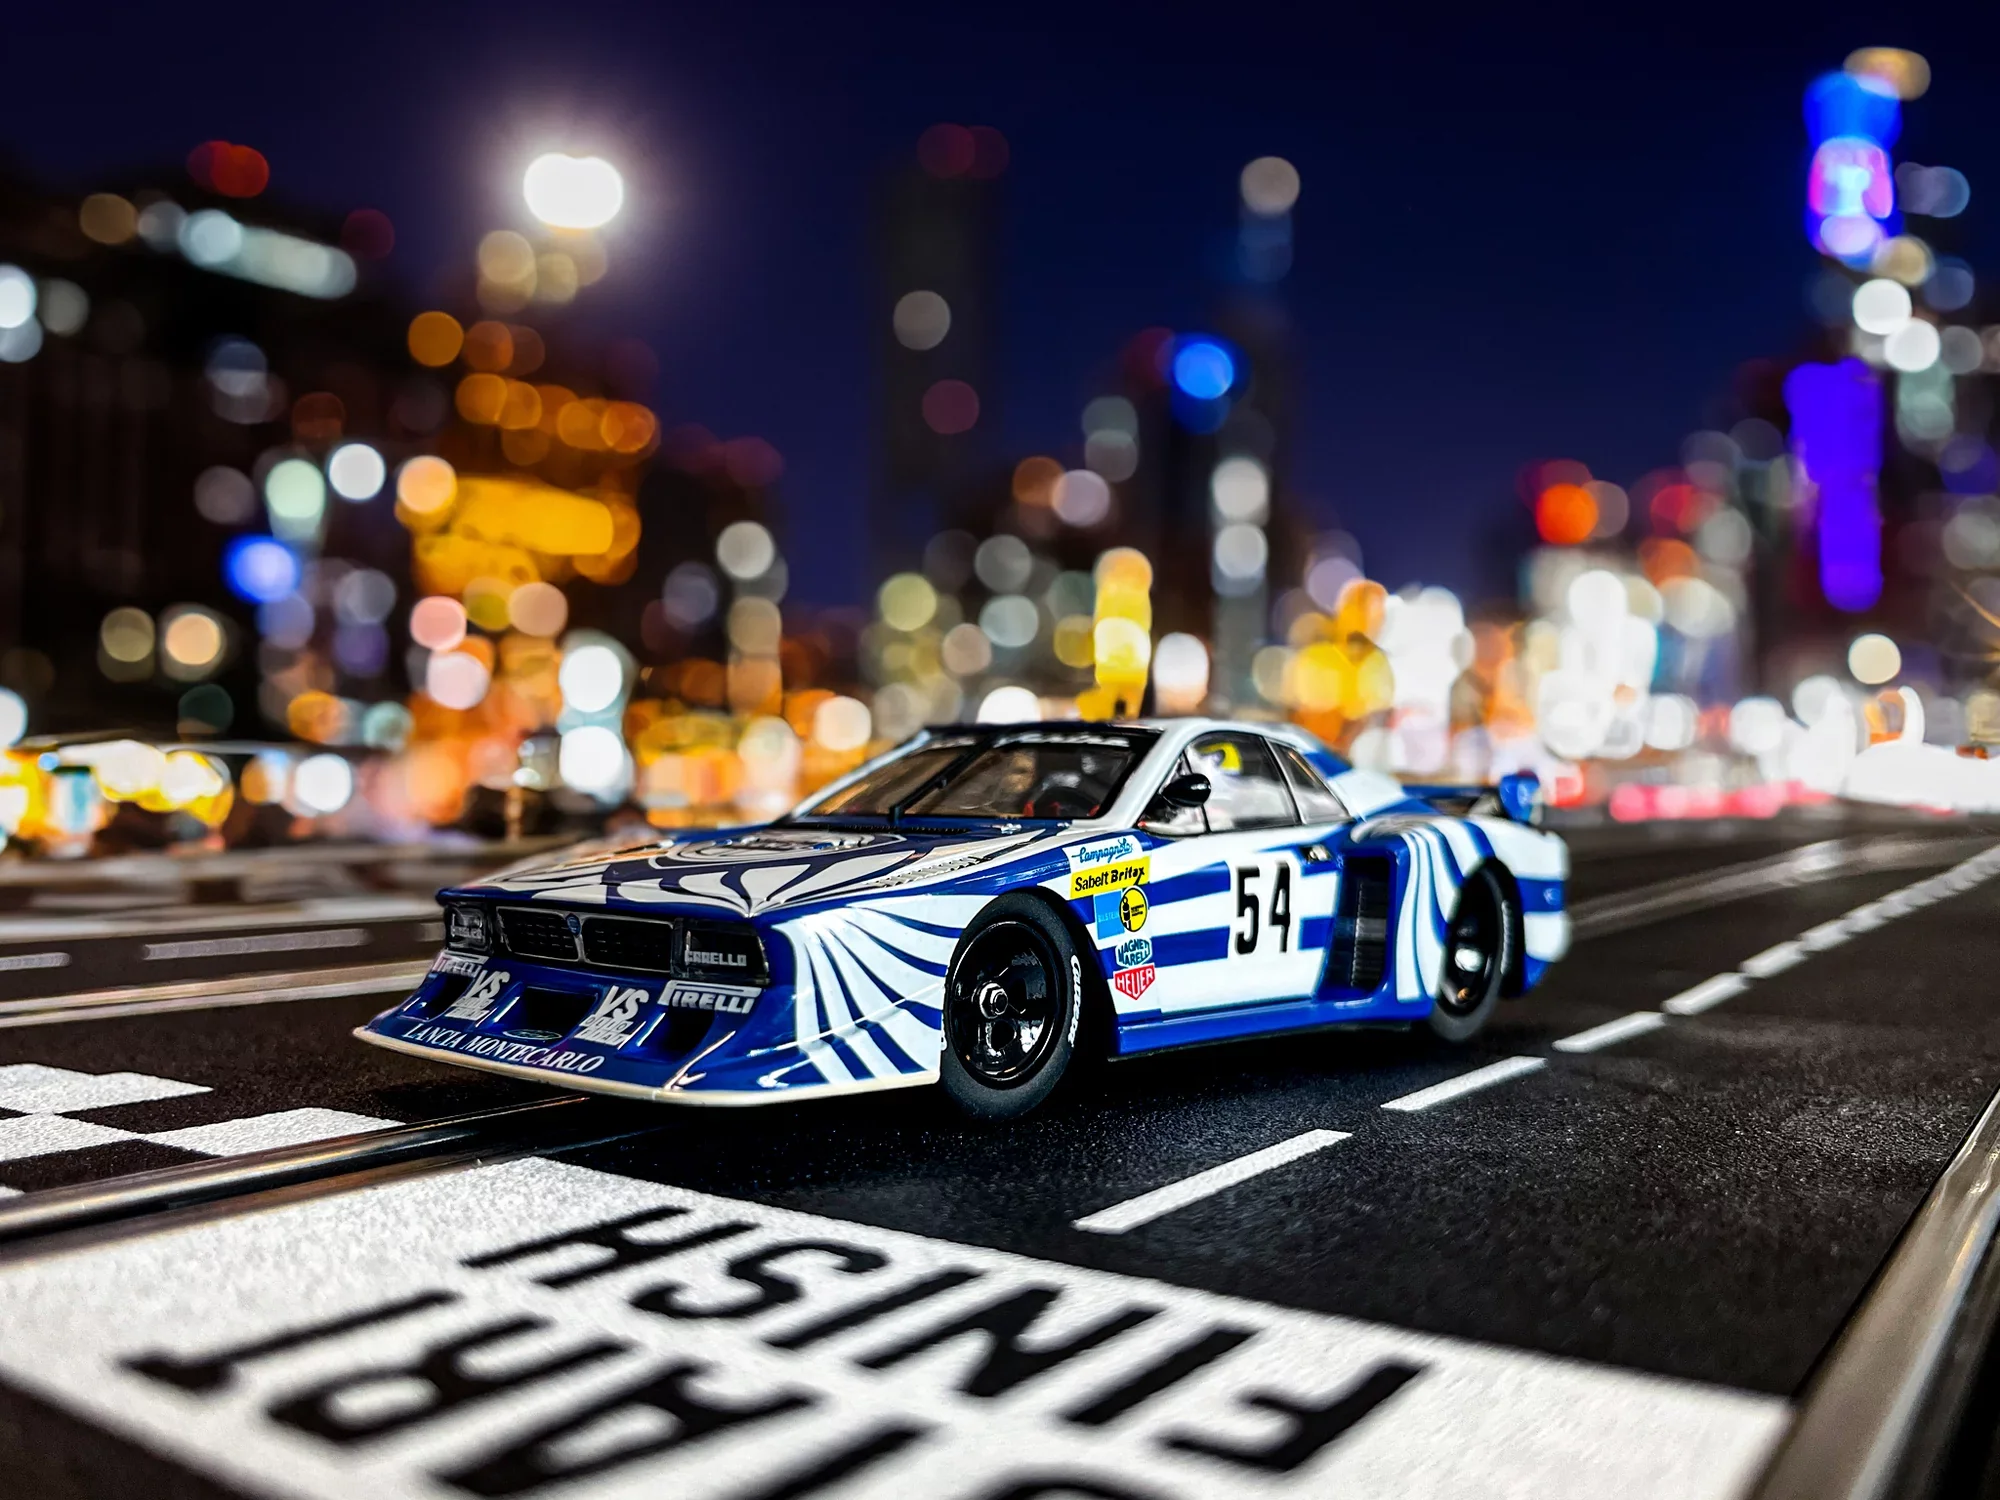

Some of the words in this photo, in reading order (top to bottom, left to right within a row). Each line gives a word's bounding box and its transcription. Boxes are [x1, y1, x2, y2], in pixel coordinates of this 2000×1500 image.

[1075, 871, 1109, 892] Sabelt
[1235, 861, 1291, 955] 54
[463, 970, 511, 1001] VS
[657, 979, 762, 1014] PIRELLI
[1116, 967, 1154, 998] HEUER
[593, 985, 649, 1022] VS
[403, 1023, 462, 1048] LANCIA
[459, 1035, 606, 1073] MONTECARLO
[457, 1206, 1428, 1472] FINISH
